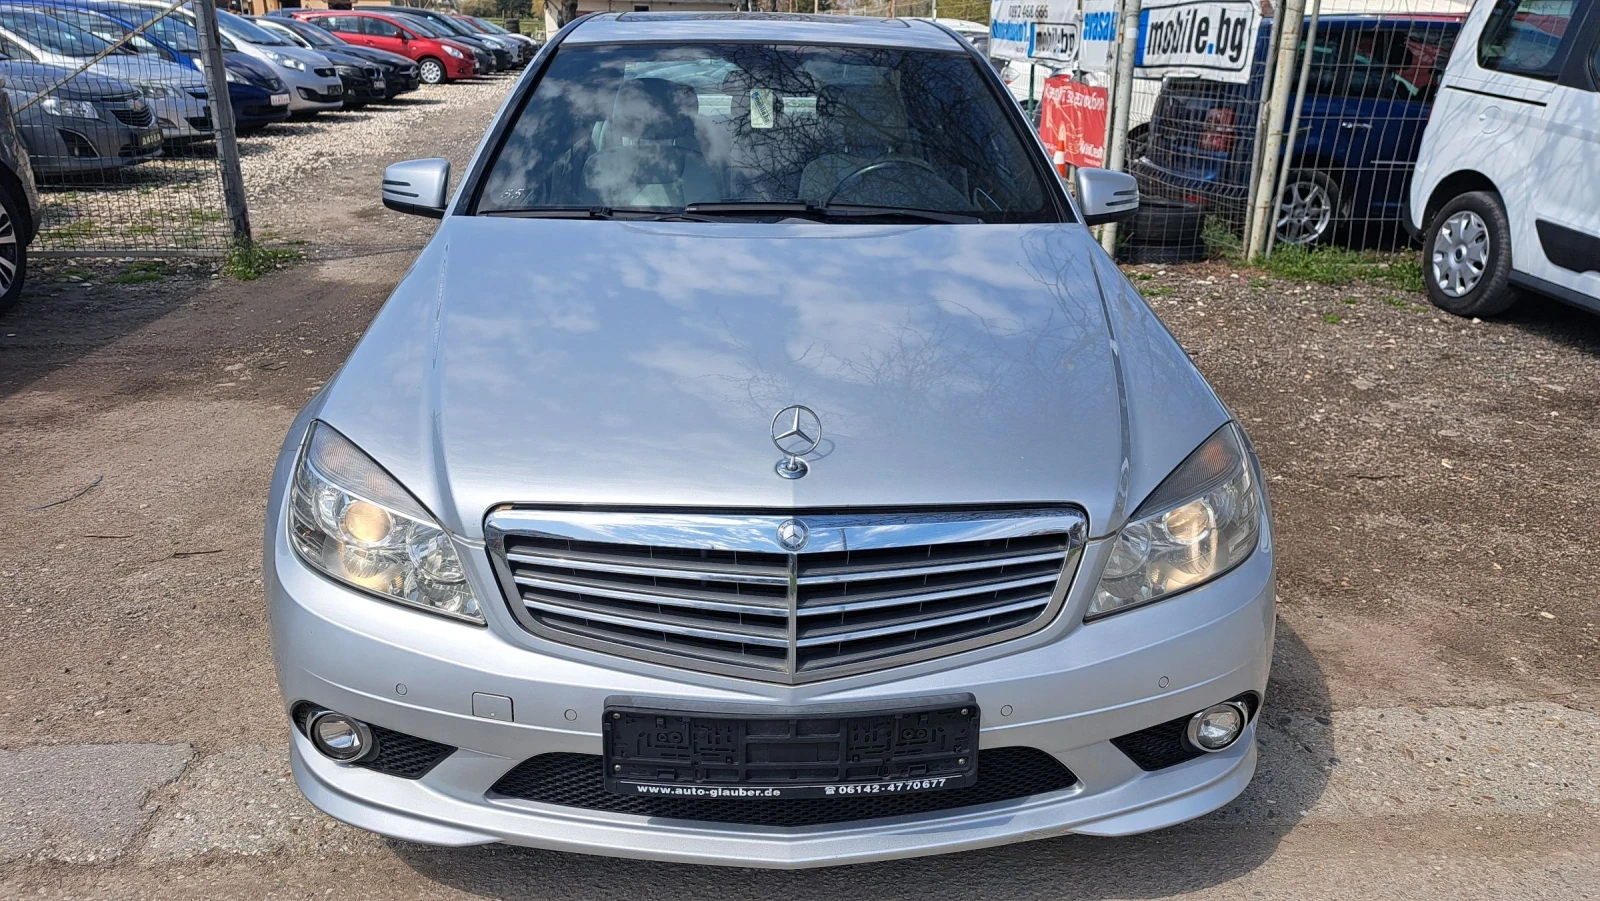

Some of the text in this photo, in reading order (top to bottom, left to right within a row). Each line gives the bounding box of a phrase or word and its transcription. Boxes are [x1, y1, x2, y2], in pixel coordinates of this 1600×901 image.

[1022, 5, 1034, 18] 468
[1035, 5, 1049, 18] 666
[1147, 8, 1246, 63] mobile.bg
[637, 784, 781, 798] www.auto-glauber.de
